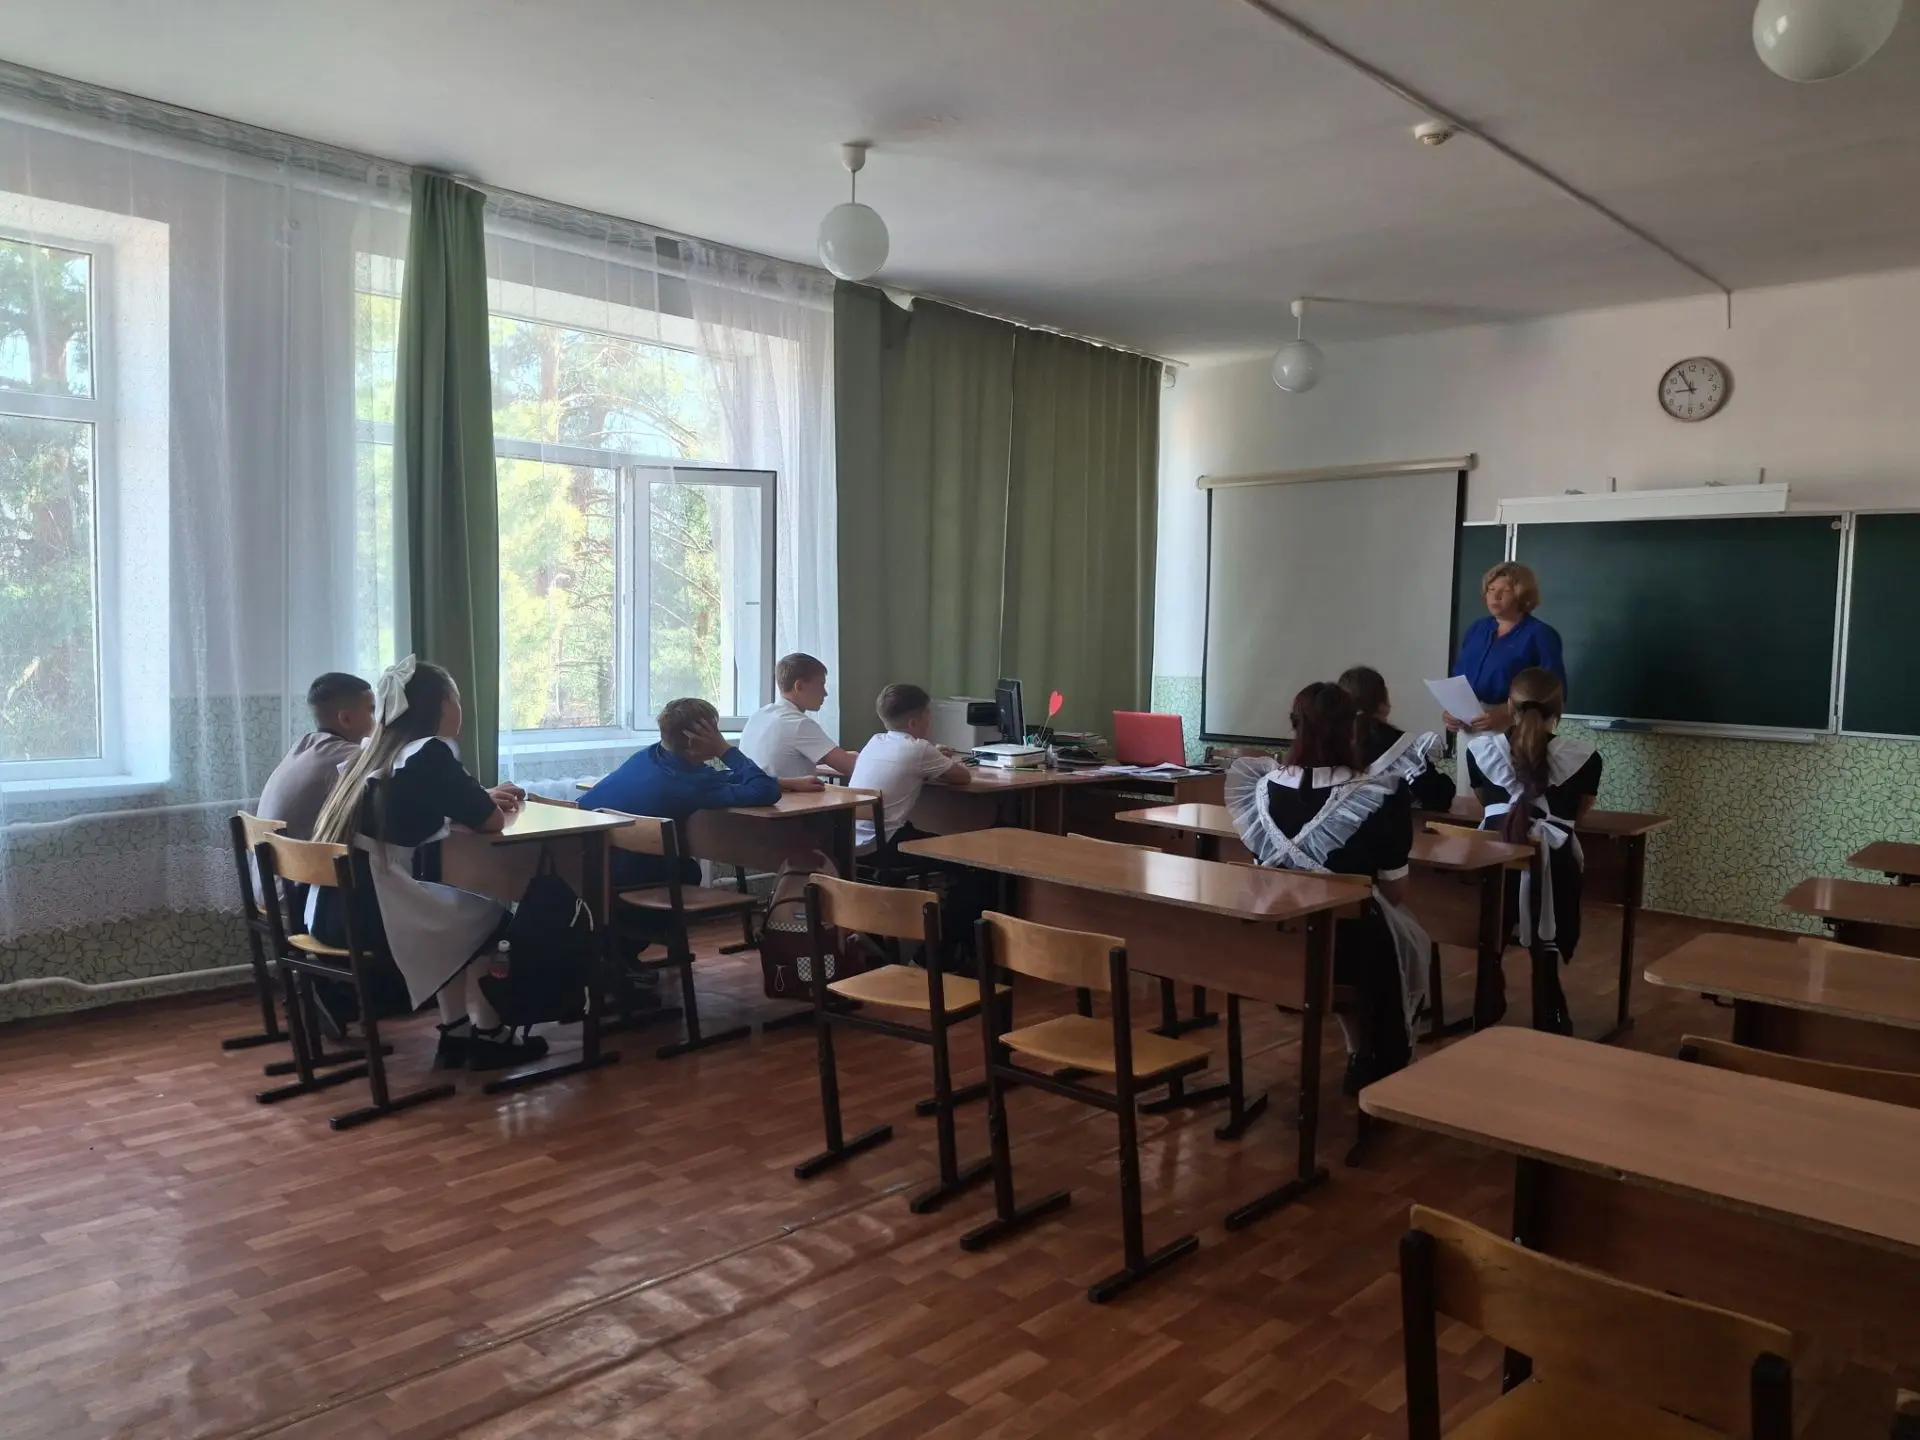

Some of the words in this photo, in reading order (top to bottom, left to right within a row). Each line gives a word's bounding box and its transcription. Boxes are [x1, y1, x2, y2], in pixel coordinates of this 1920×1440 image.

[1688, 364, 1697, 372] 12
[1701, 367, 1705, 375] 1
[1712, 384, 1717, 392] 3
[1700, 402, 1705, 410] 5
